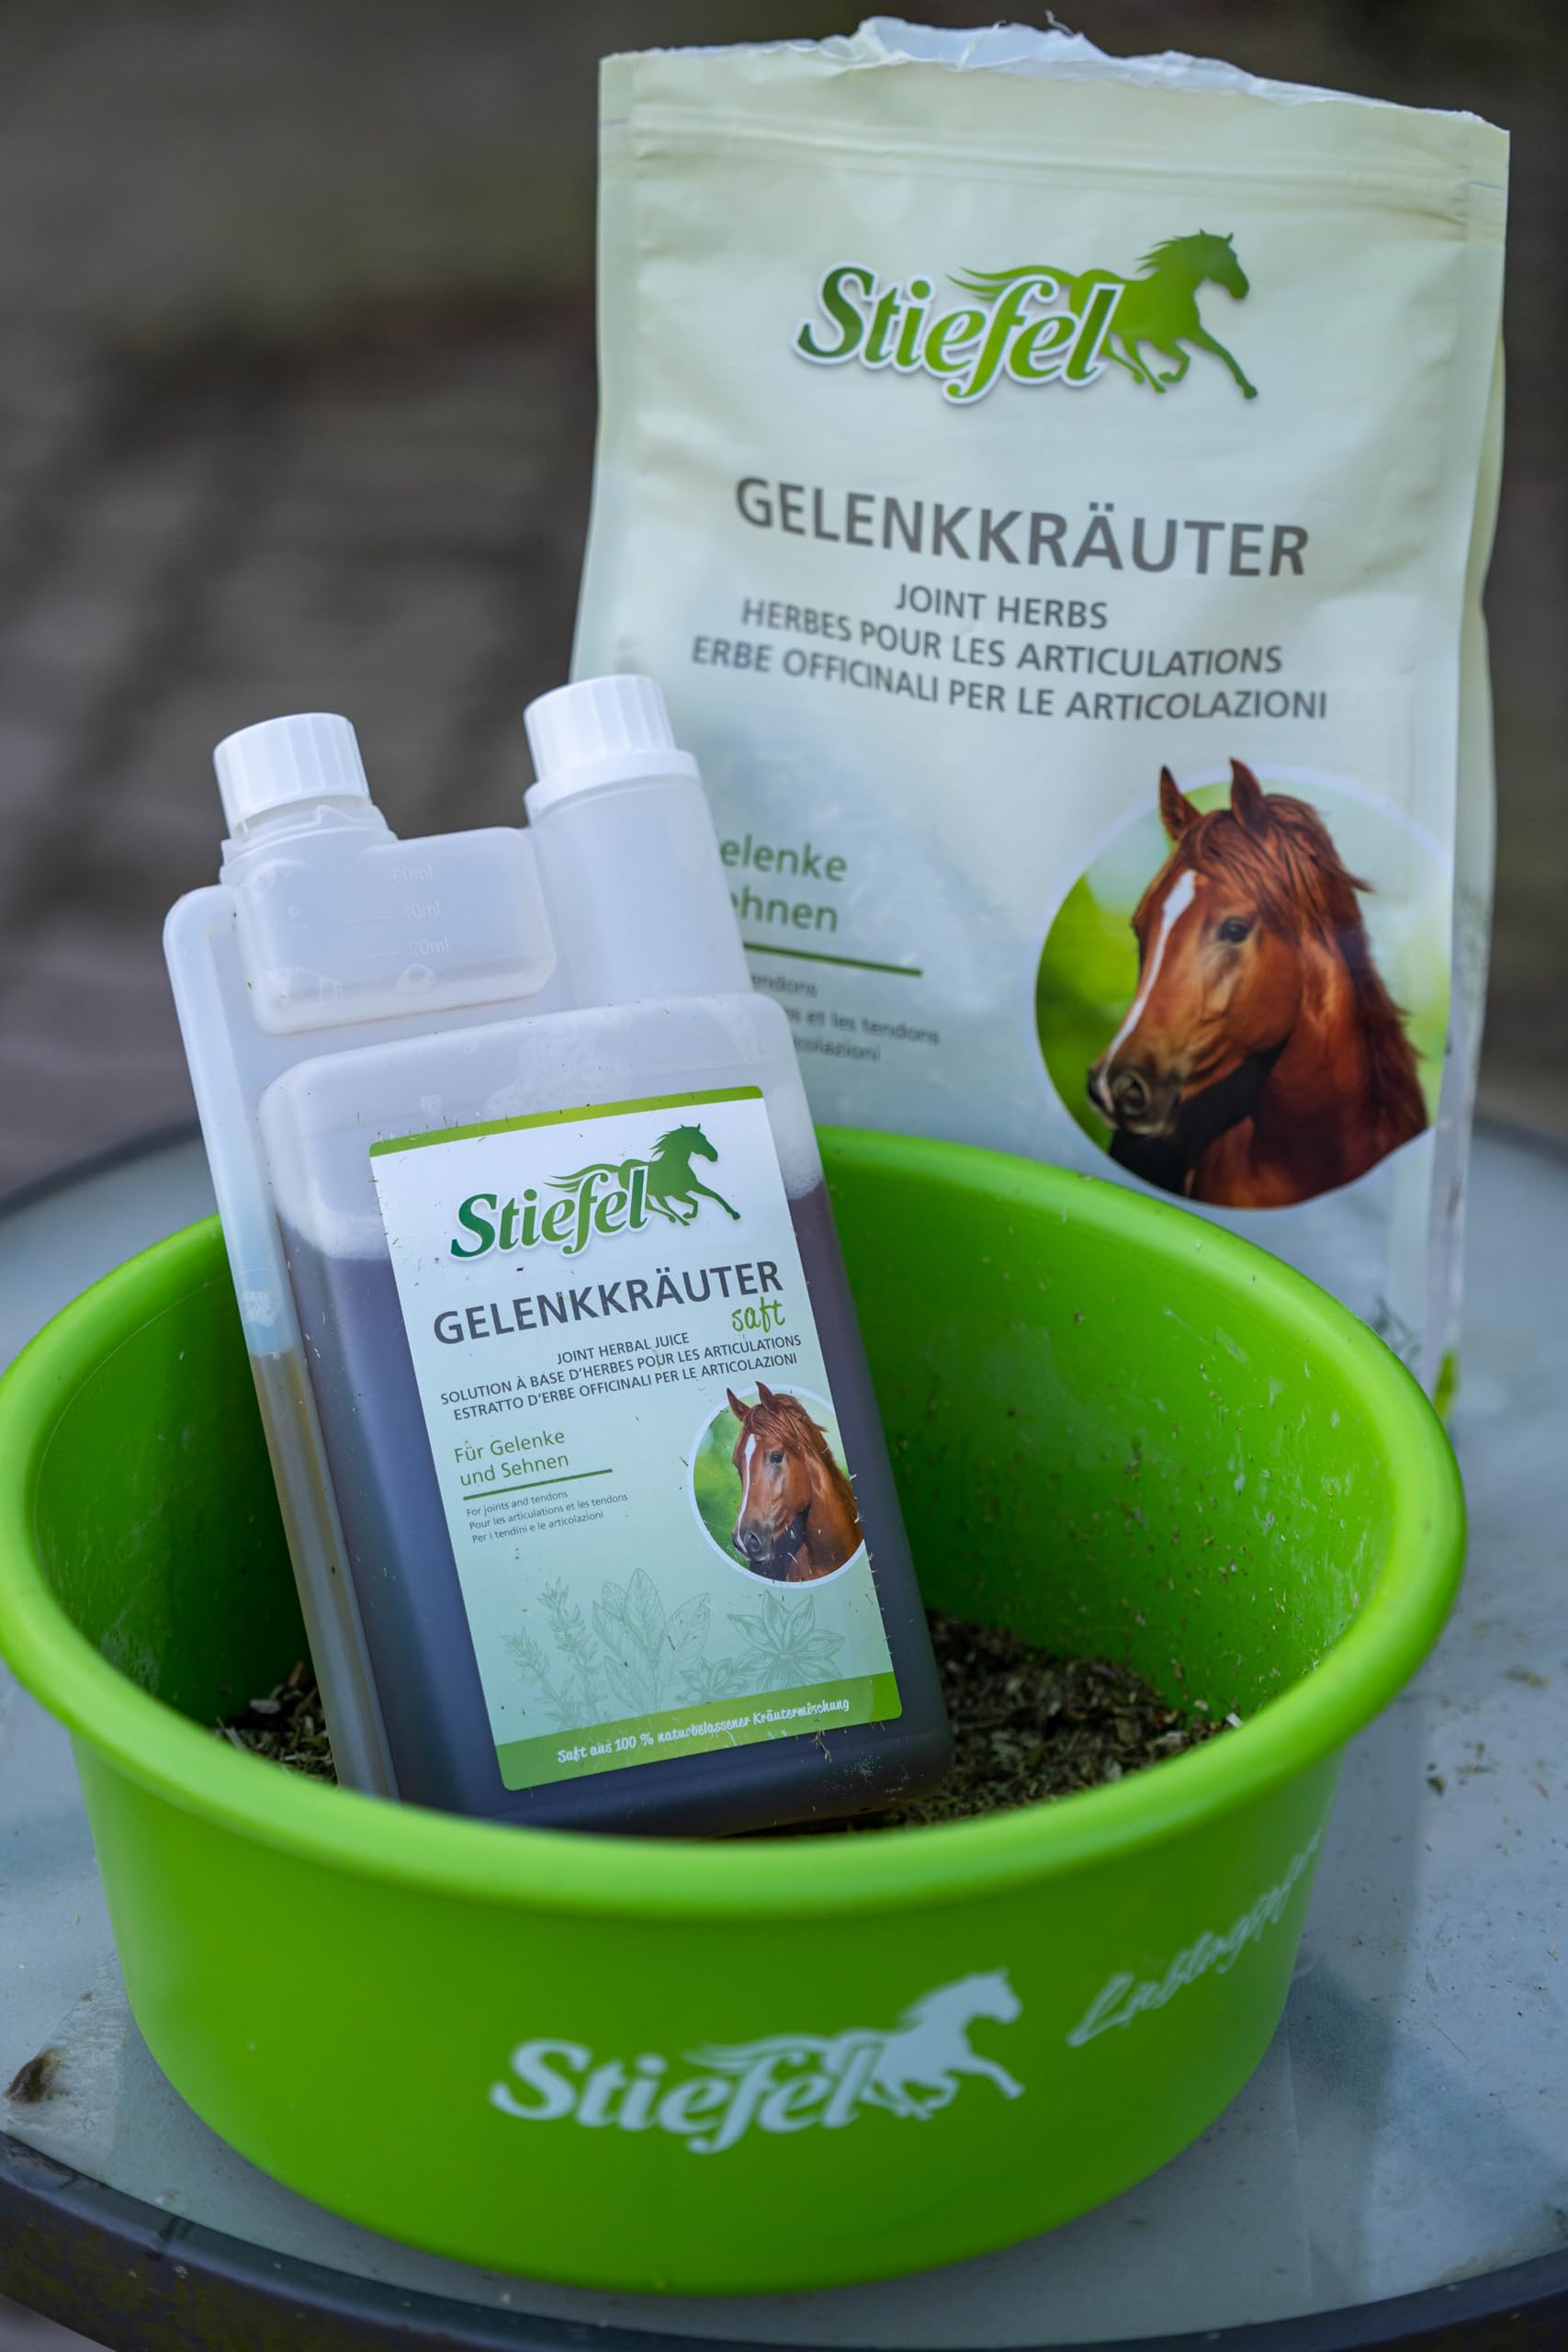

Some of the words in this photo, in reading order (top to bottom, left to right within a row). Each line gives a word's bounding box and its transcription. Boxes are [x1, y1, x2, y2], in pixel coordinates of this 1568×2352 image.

[795, 263, 1125, 401] Stiefel
[736, 474, 1310, 578] GELENKKRÄUTER
[895, 582, 987, 622] JOINT
[997, 595, 1109, 630] HERBS
[740, 597, 852, 643] HERBES
[860, 619, 942, 661] POUR
[952, 634, 1007, 669] LES
[1015, 642, 1283, 678] ARTICULATIONS
[690, 635, 774, 673] ERBE
[782, 648, 940, 704] OFFICINALI
[948, 678, 1008, 714] PER
[1017, 686, 1055, 717] LE
[1065, 690, 1328, 722] ARTICOLAZIONI
[718, 831, 849, 884] elenke
[730, 885, 840, 934] hnen
[448, 1166, 649, 1259] Stiefel
[433, 1260, 784, 1345] GELENKKRÄUTER
[730, 1295, 786, 1334] saft
[440, 1380, 513, 1406] SOLUTION
[516, 1374, 527, 1391] À
[529, 1370, 566, 1388] BASE
[637, 1352, 676, 1370] POUR
[677, 1348, 701, 1364] LES
[704, 1334, 802, 1360] ARTICULATIONS
[557, 1347, 595, 1366] JOINT
[598, 1336, 652, 1359] HERBAL
[654, 1331, 691, 1350] JUICE
[453, 1396, 525, 1421] ESTRATTO
[579, 1374, 653, 1397] OFFICINALI
[655, 1370, 681, 1385] PER
[682, 1366, 698, 1381] LE
[701, 1352, 798, 1378] ARTICOLAZIONI
[453, 1444, 485, 1464] Für
[489, 1430, 567, 1457] Gelenke
[459, 1464, 497, 1487] und
[501, 1453, 570, 1479] Sehnen
[466, 1507, 482, 1518] For
[483, 1502, 511, 1518] joints
[511, 1498, 530, 1510] and
[530, 1489, 570, 1505] tendons
[468, 1519, 491, 1531] Pour
[492, 1515, 507, 1526] les
[507, 1503, 565, 1525] articulations
[566, 1501, 577, 1512] et
[576, 1498, 591, 1510] les
[591, 1492, 629, 1508] tendons
[471, 1532, 489, 1544] Per
[493, 1522, 528, 1539] tendini
[529, 1523, 537, 1533] e
[536, 1520, 547, 1532] le
[547, 1510, 605, 1530] articolazioni
[557, 1746, 589, 1763] Saft
[589, 1742, 613, 1758] aus
[615, 1736, 637, 1753] 100
[638, 1732, 655, 1747] %
[657, 1715, 752, 1744] naturbelassener
[751, 1697, 851, 1725] Kräutermischung
[488, 2037, 888, 2155] Stiefel
